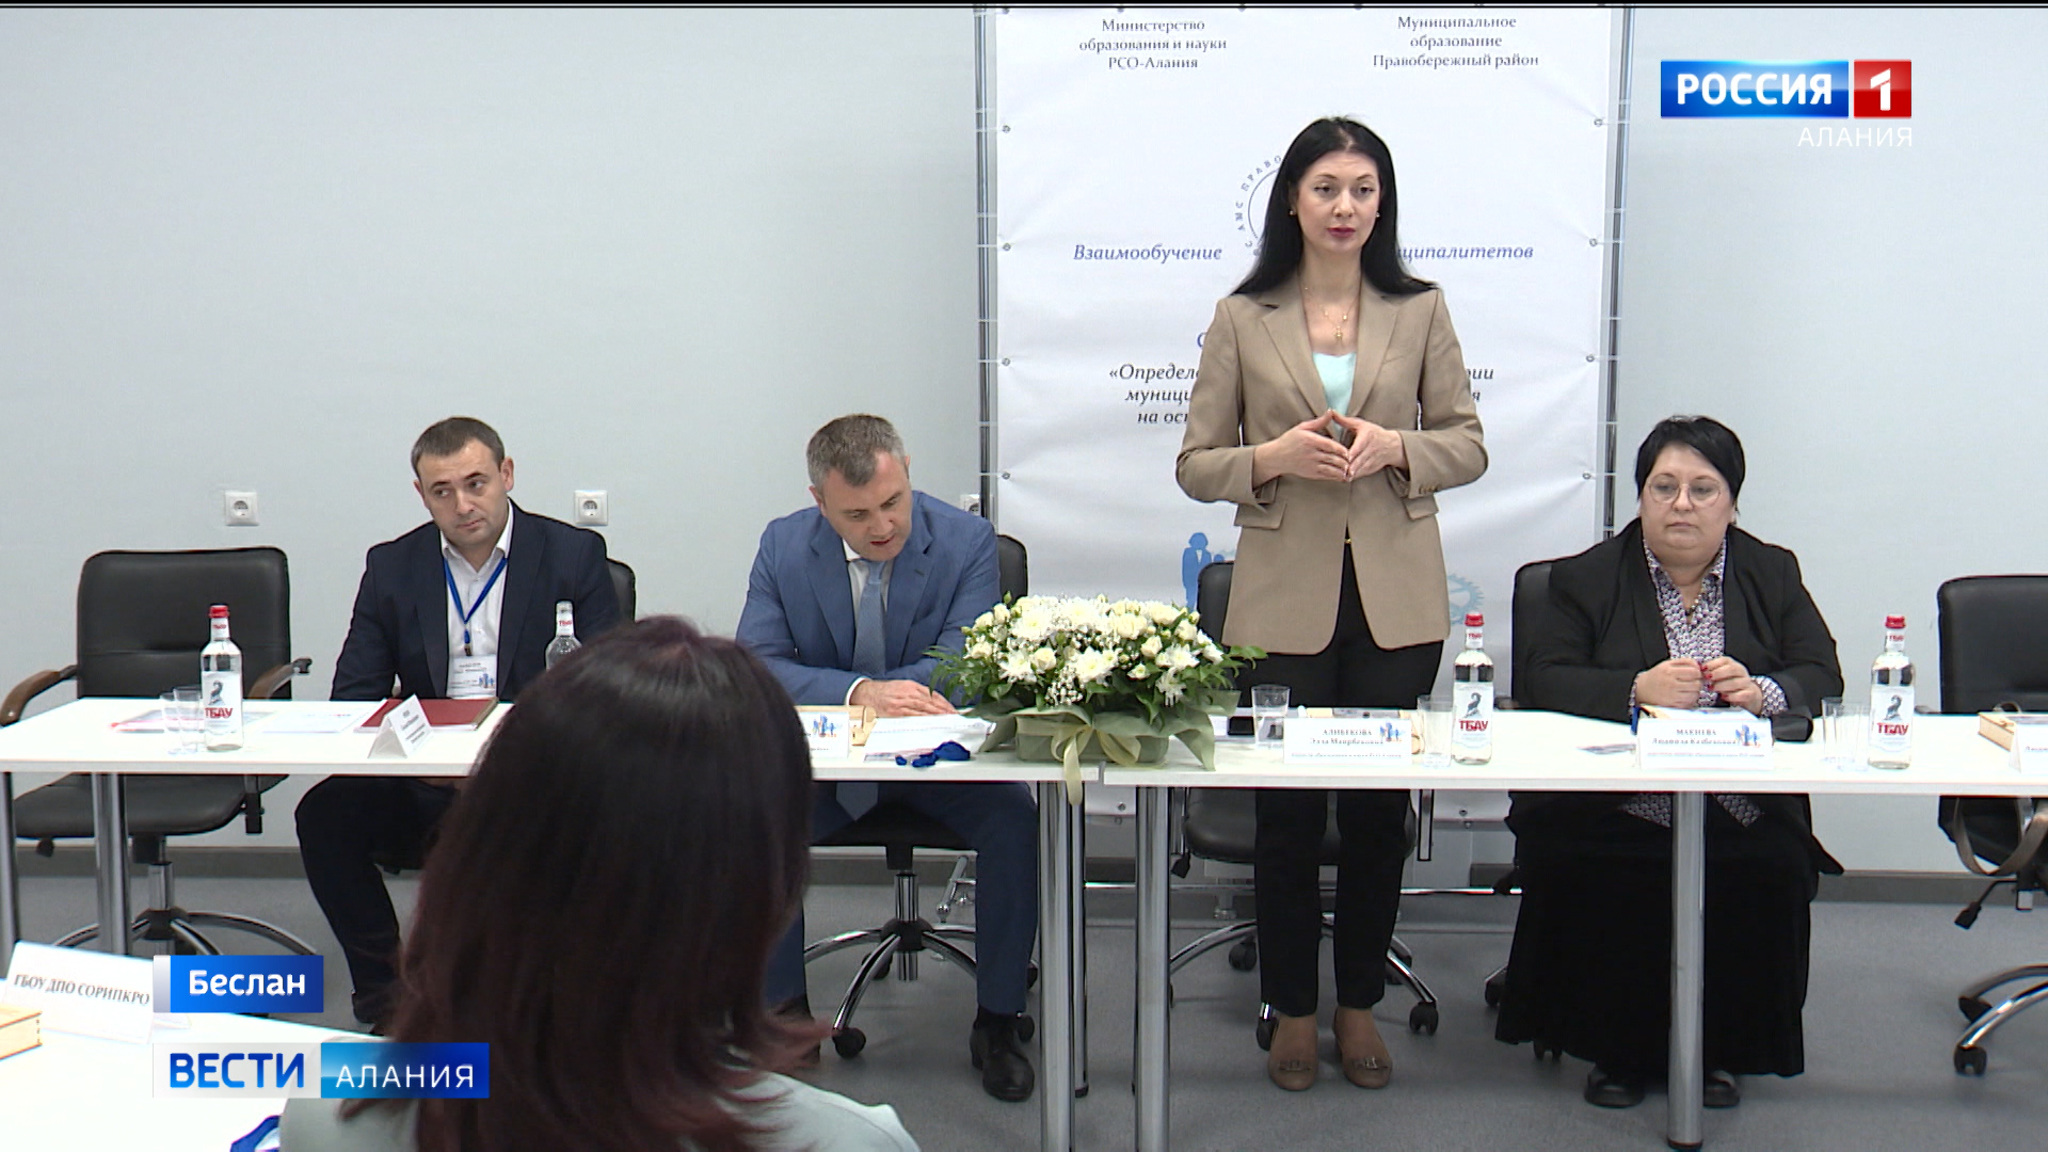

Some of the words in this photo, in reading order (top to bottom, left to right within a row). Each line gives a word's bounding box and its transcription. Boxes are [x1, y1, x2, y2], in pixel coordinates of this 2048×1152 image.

[1102, 19, 1205, 33] Министерство
[1398, 16, 1517, 31] Муниципальное
[1079, 37, 1169, 53] образования
[1173, 40, 1181, 48] и
[1186, 40, 1227, 52] науки
[1410, 34, 1502, 50] образование
[1108, 56, 1198, 70] РСО-Алания
[1373, 54, 1491, 69] Правобережный
[1495, 54, 1538, 69] район
[1073, 244, 1222, 264] Взаимообучение
[1400, 246, 1534, 263] ципалитетов
[1137, 413, 1158, 424] на
[205, 707, 233, 718] ТБАУ
[1459, 720, 1488, 731] ТБАУ
[1877, 723, 1908, 735] ТБАУ
[14, 974, 46, 989] ГБОУ
[46, 978, 76, 994] ДПО
[78, 983, 150, 1005] СОРИПКРО
